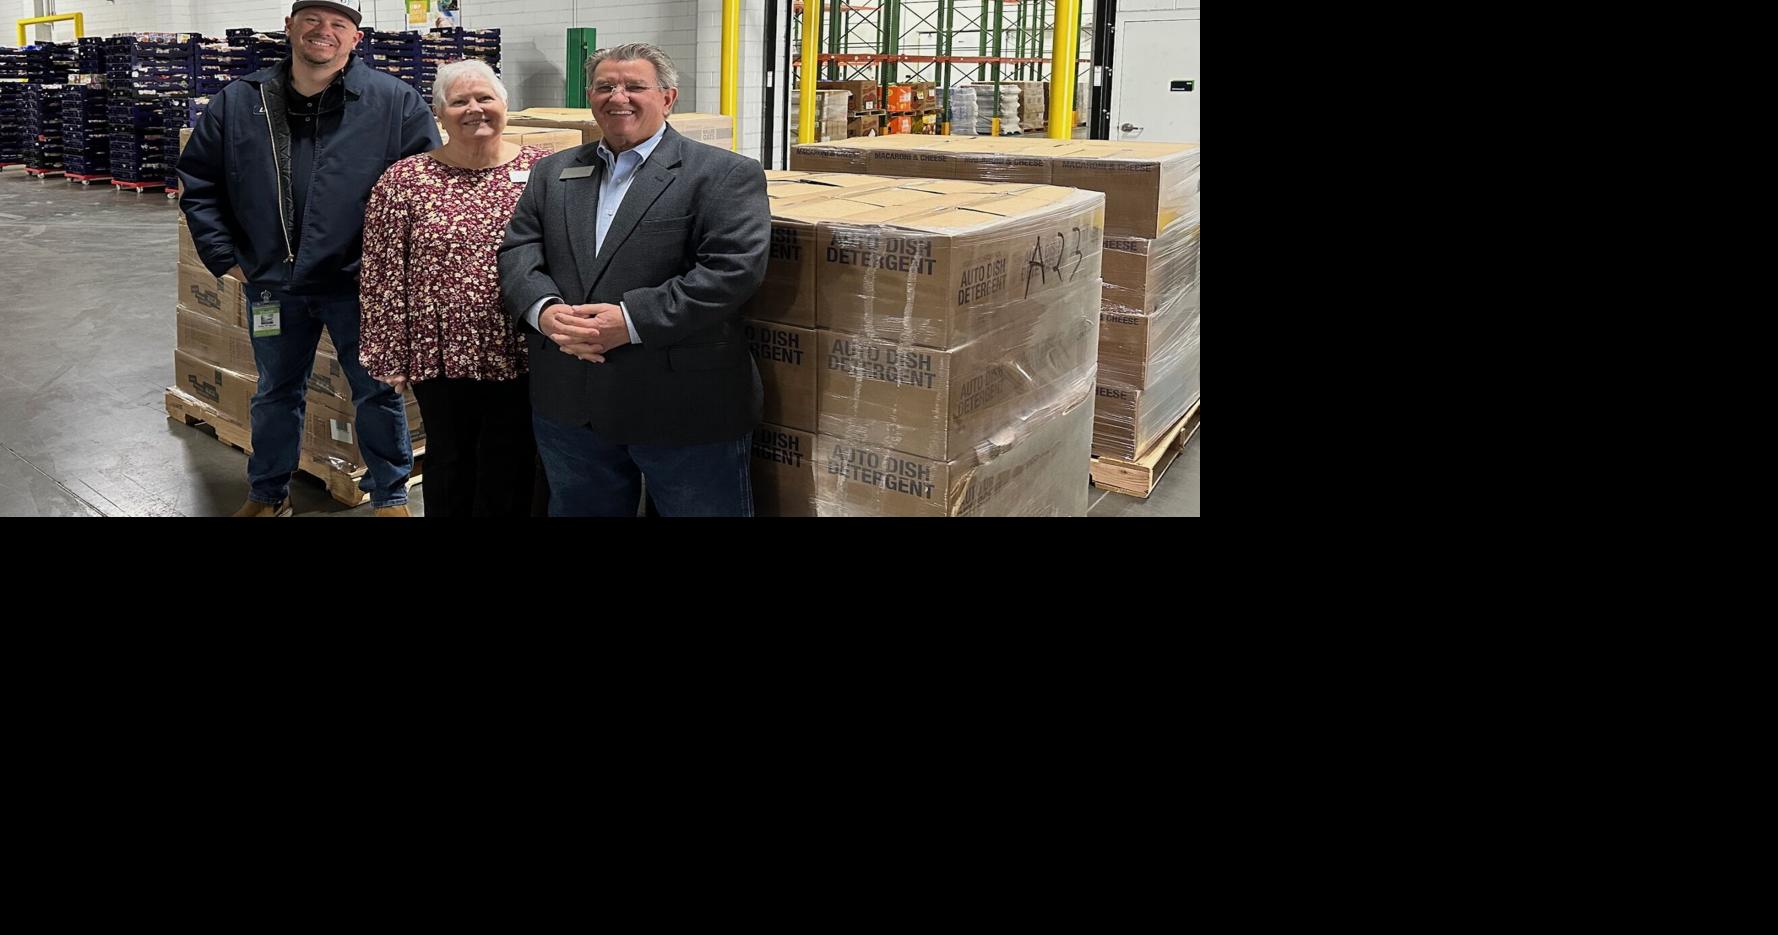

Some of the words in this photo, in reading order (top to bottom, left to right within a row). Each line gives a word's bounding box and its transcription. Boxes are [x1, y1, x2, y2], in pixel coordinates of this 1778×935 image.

[874, 152, 912, 161] MACARONI
[920, 154, 947, 162] CHEESE
[771, 228, 798, 244] ISH
[886, 236, 932, 257] DISH
[1103, 240, 1138, 252] HEESE
[827, 247, 937, 275] DETERGENT
[960, 265, 985, 288] AUTO
[986, 258, 1006, 278] DISH
[958, 273, 1007, 306] DETERGENT
[1106, 314, 1140, 326] CHEESE
[760, 328, 800, 349] DISH
[750, 342, 804, 366] RGENT
[831, 338, 880, 361] AUTO
[886, 350, 932, 372] DISH
[827, 354, 937, 389] DETERGENT
[761, 428, 800, 449] DISH
[751, 442, 804, 468] RGENT
[831, 444, 880, 469] AUTO
[886, 456, 932, 482] DISH
[827, 461, 936, 500] DETERGENT
